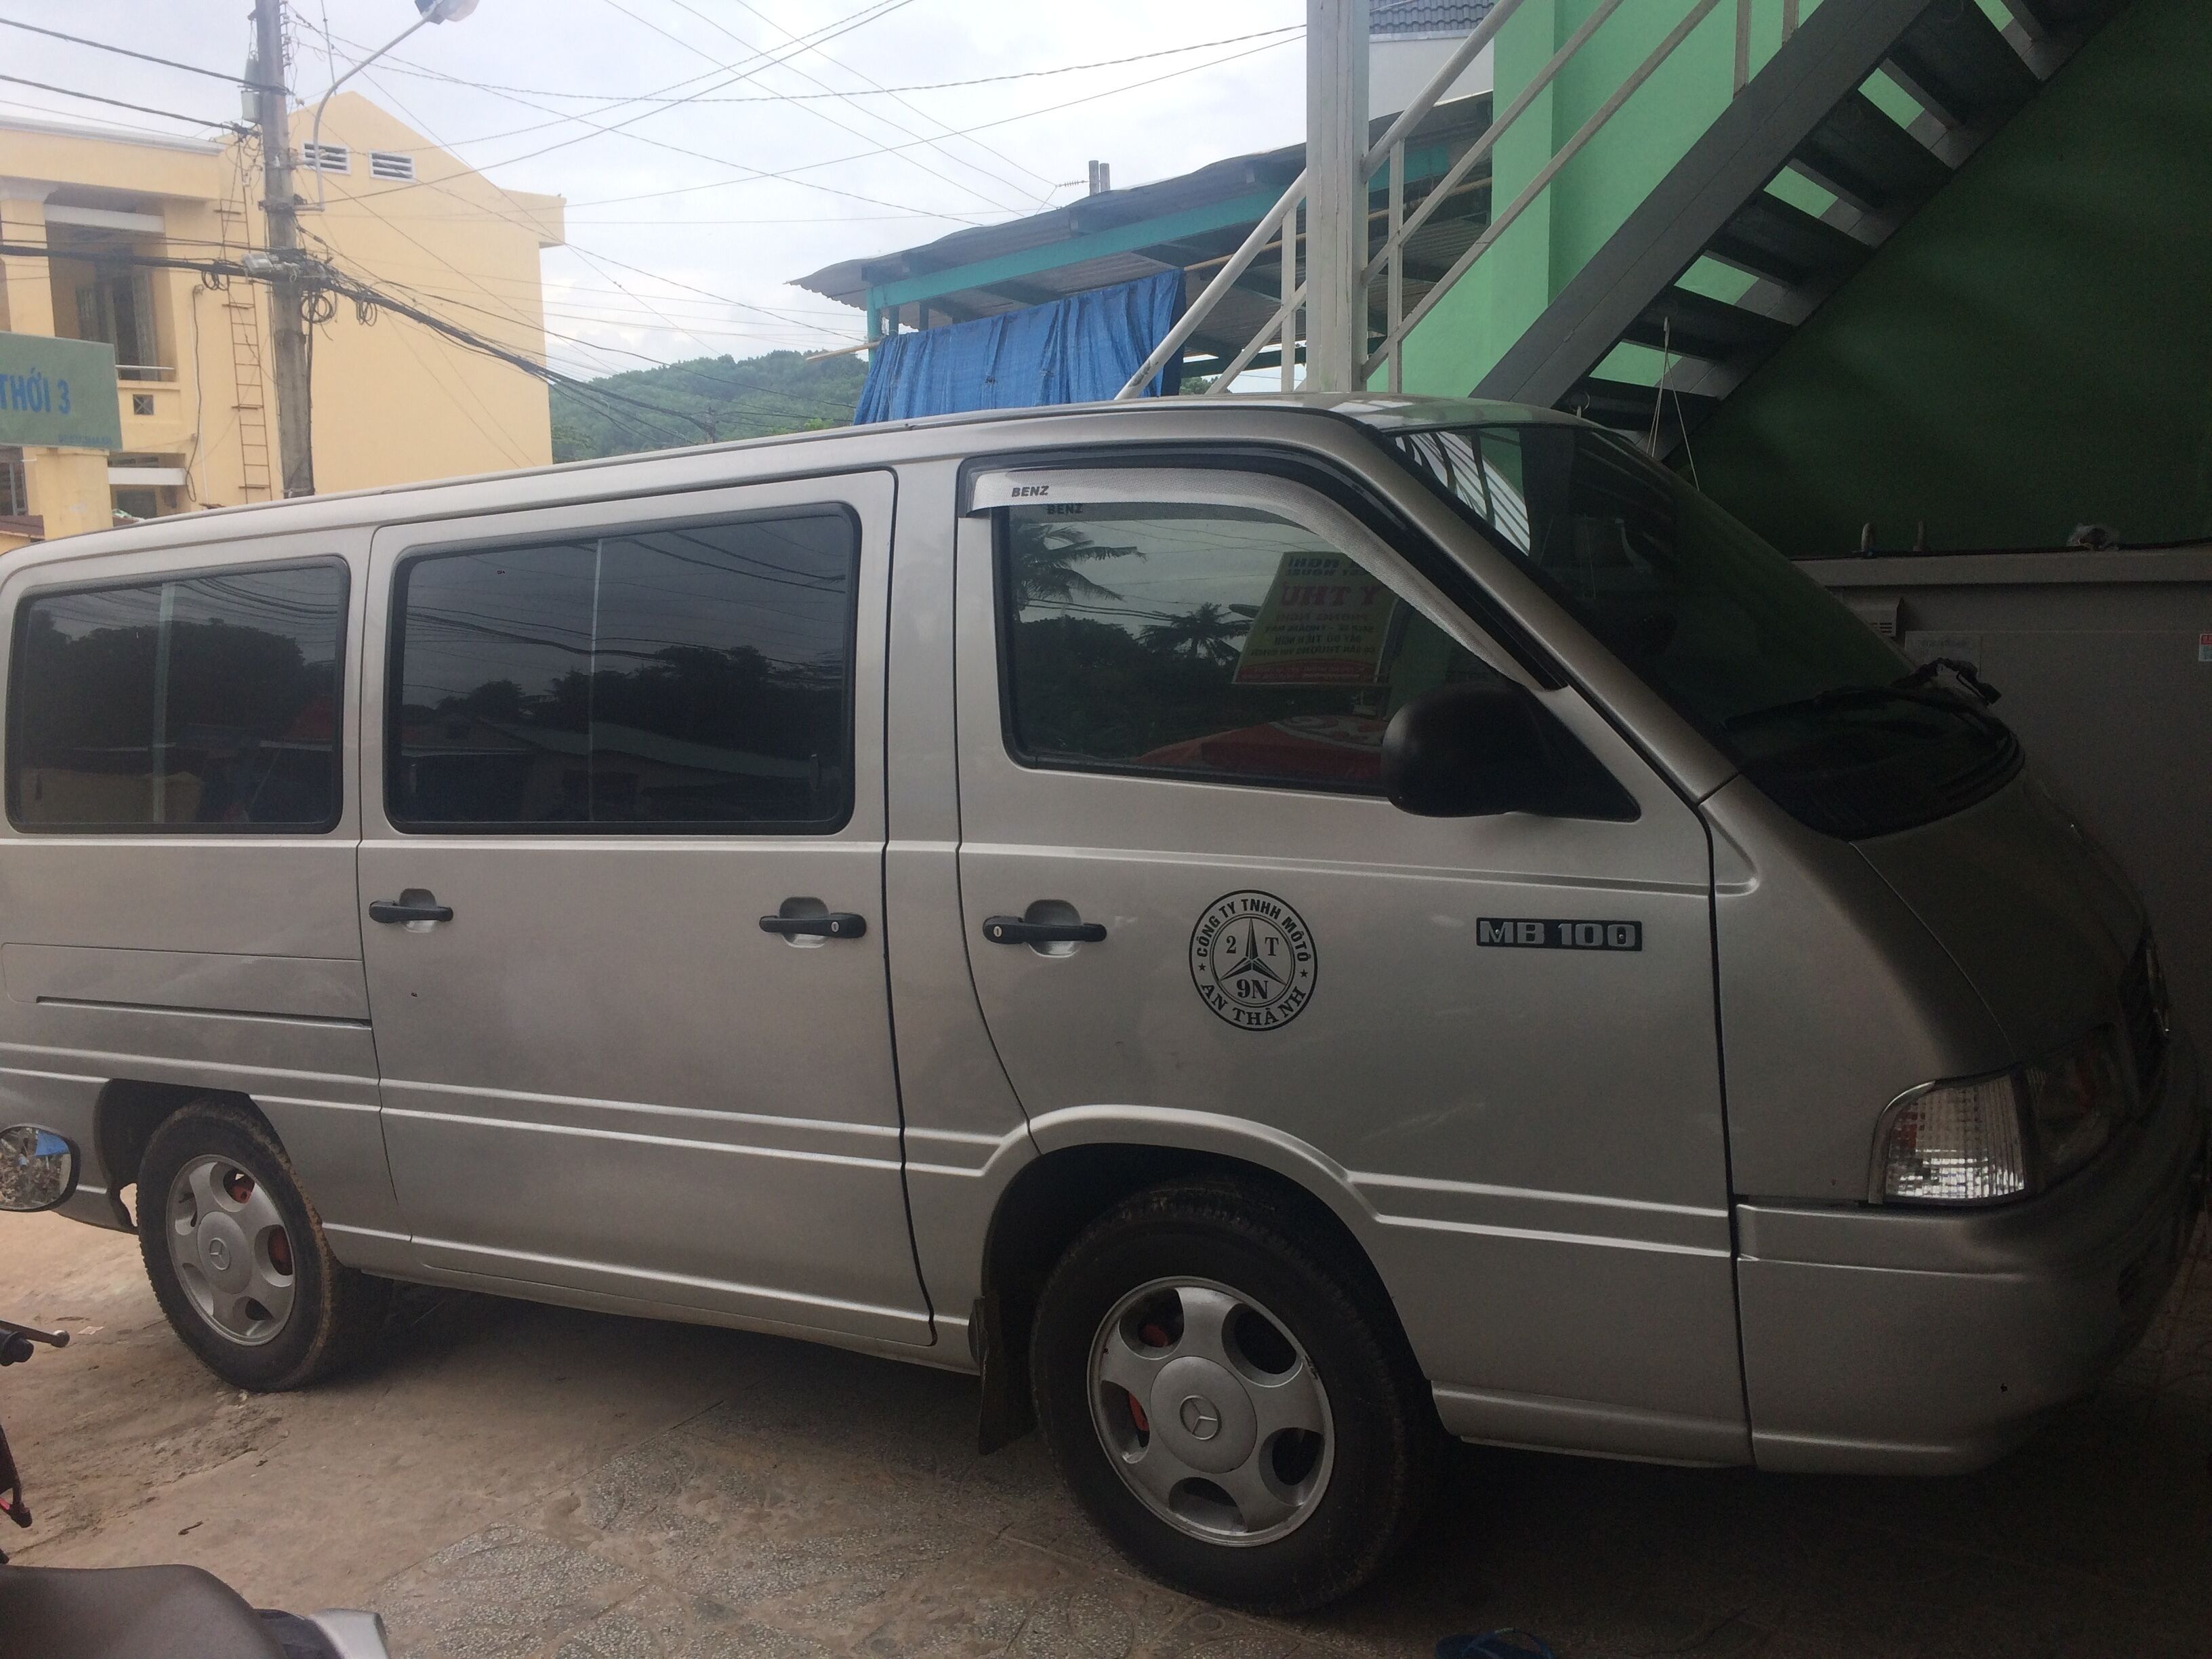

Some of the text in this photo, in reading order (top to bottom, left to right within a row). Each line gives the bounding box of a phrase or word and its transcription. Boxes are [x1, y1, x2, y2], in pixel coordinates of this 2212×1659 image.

[57, 379, 70, 415] 3
[1011, 485, 1049, 497] BENZ
[1196, 915, 1221, 957] CÔNG
[1218, 901, 1236, 918] TY
[1241, 899, 1282, 920] TNHH
[1480, 921, 1636, 947] MB 100
[1226, 935, 1279, 956] 2 T
[1236, 979, 1269, 1000] 9N
[1200, 983, 1307, 1025] AN THÀNH
